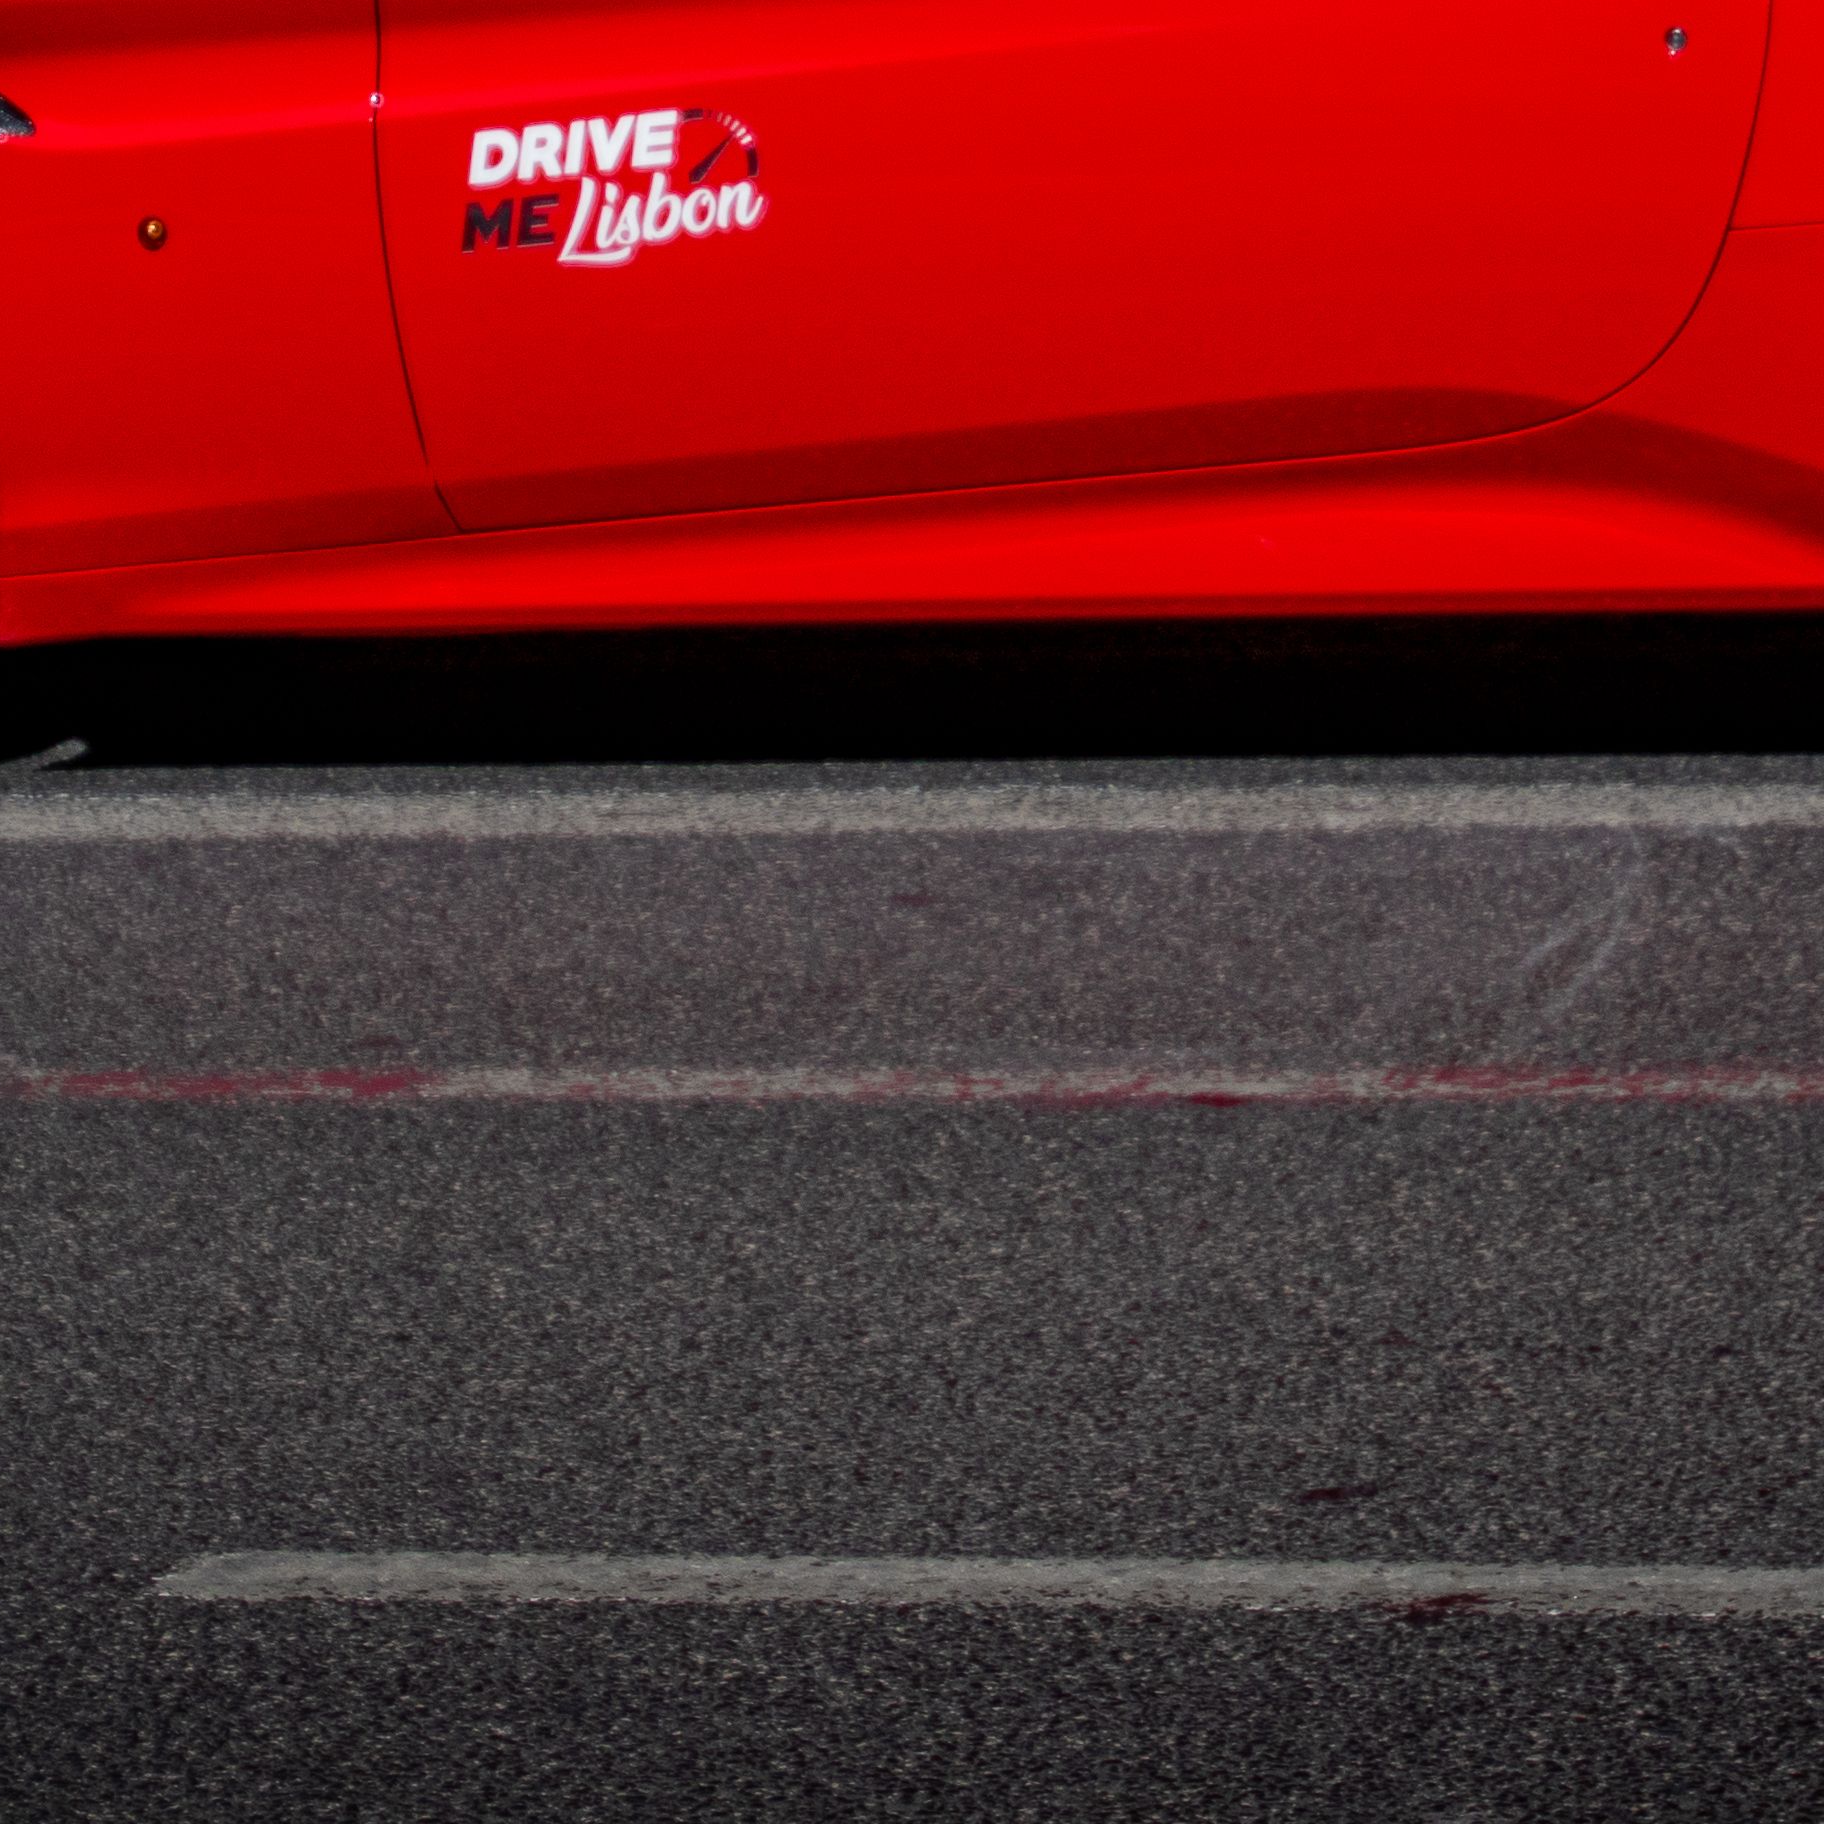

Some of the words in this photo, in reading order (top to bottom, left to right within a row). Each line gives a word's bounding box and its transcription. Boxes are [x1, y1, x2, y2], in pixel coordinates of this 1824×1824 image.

[467, 108, 678, 186] DRIVE
[461, 193, 560, 254] ME
[556, 171, 764, 264] Lisbon
